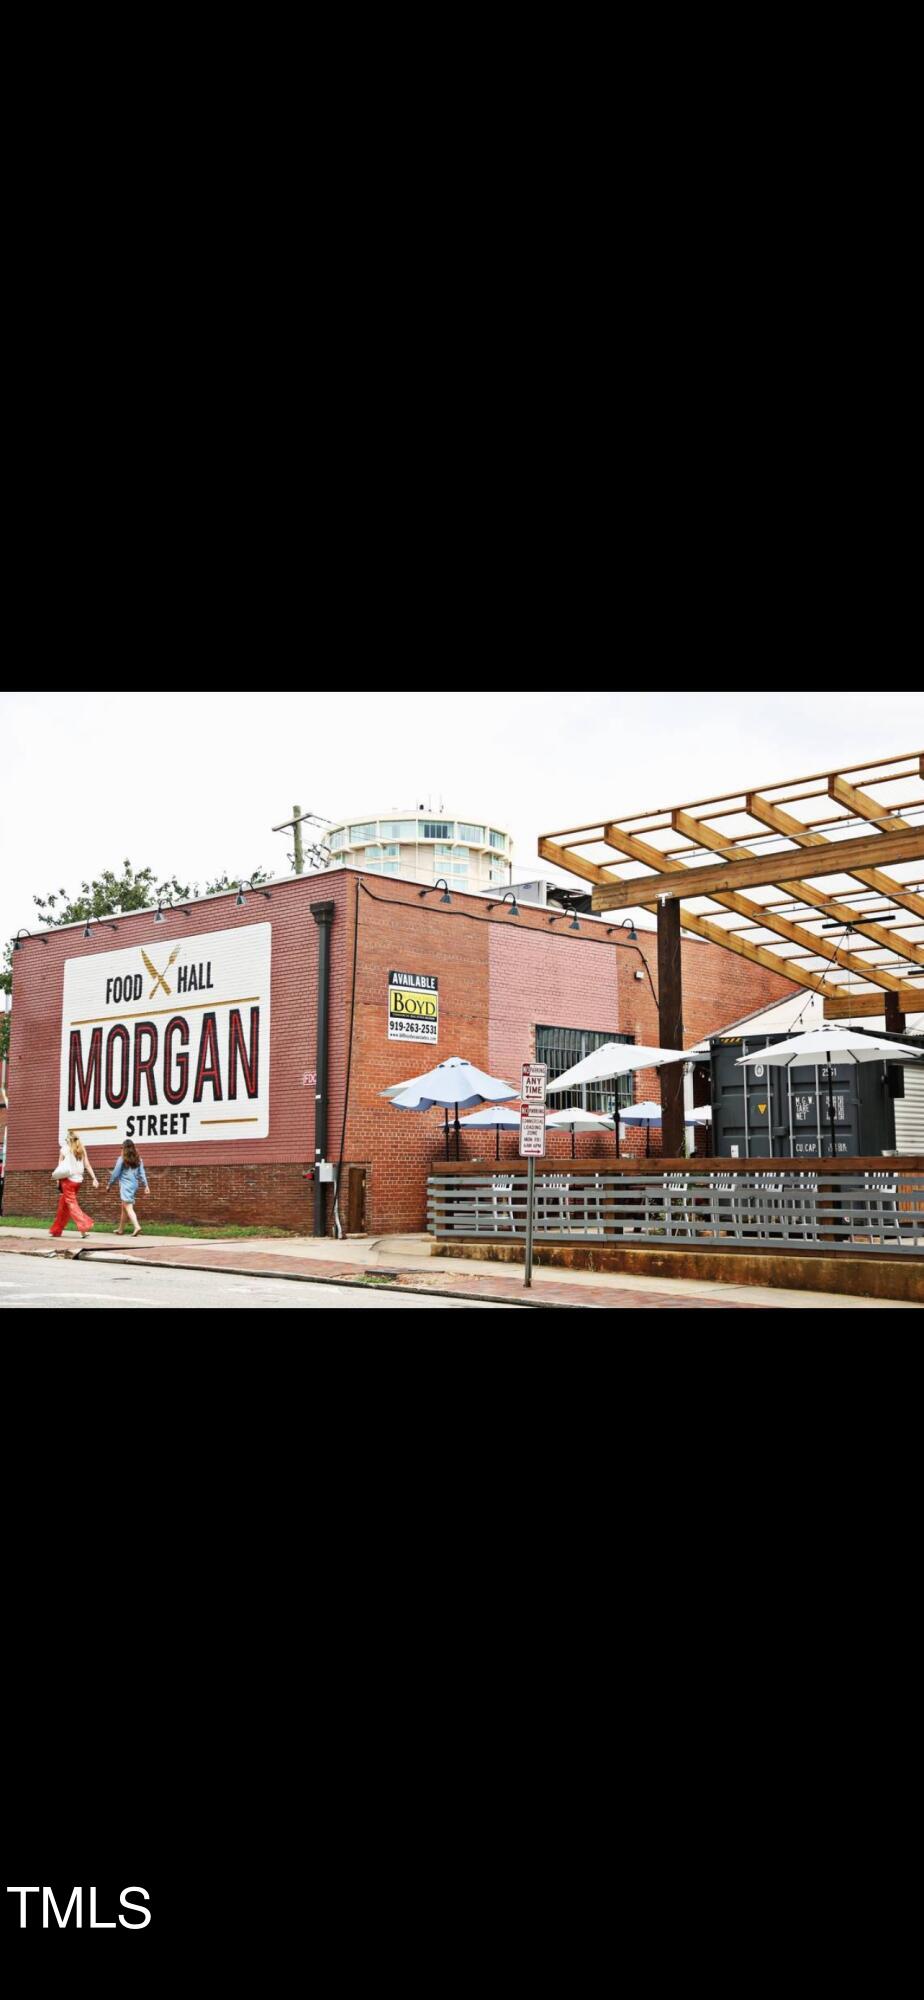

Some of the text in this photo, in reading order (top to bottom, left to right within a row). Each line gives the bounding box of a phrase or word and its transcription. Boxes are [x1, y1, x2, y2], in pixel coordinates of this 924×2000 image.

[105, 961, 214, 1004] FOOD HALL
[392, 973, 435, 989] AVAILABLE
[389, 1021, 437, 1034] 919-263-2531
[67, 1006, 259, 1112] MORGAN
[526, 1077, 541, 1085] ANY
[525, 1086, 542, 1094] TIME
[126, 1113, 190, 1137] STREET
